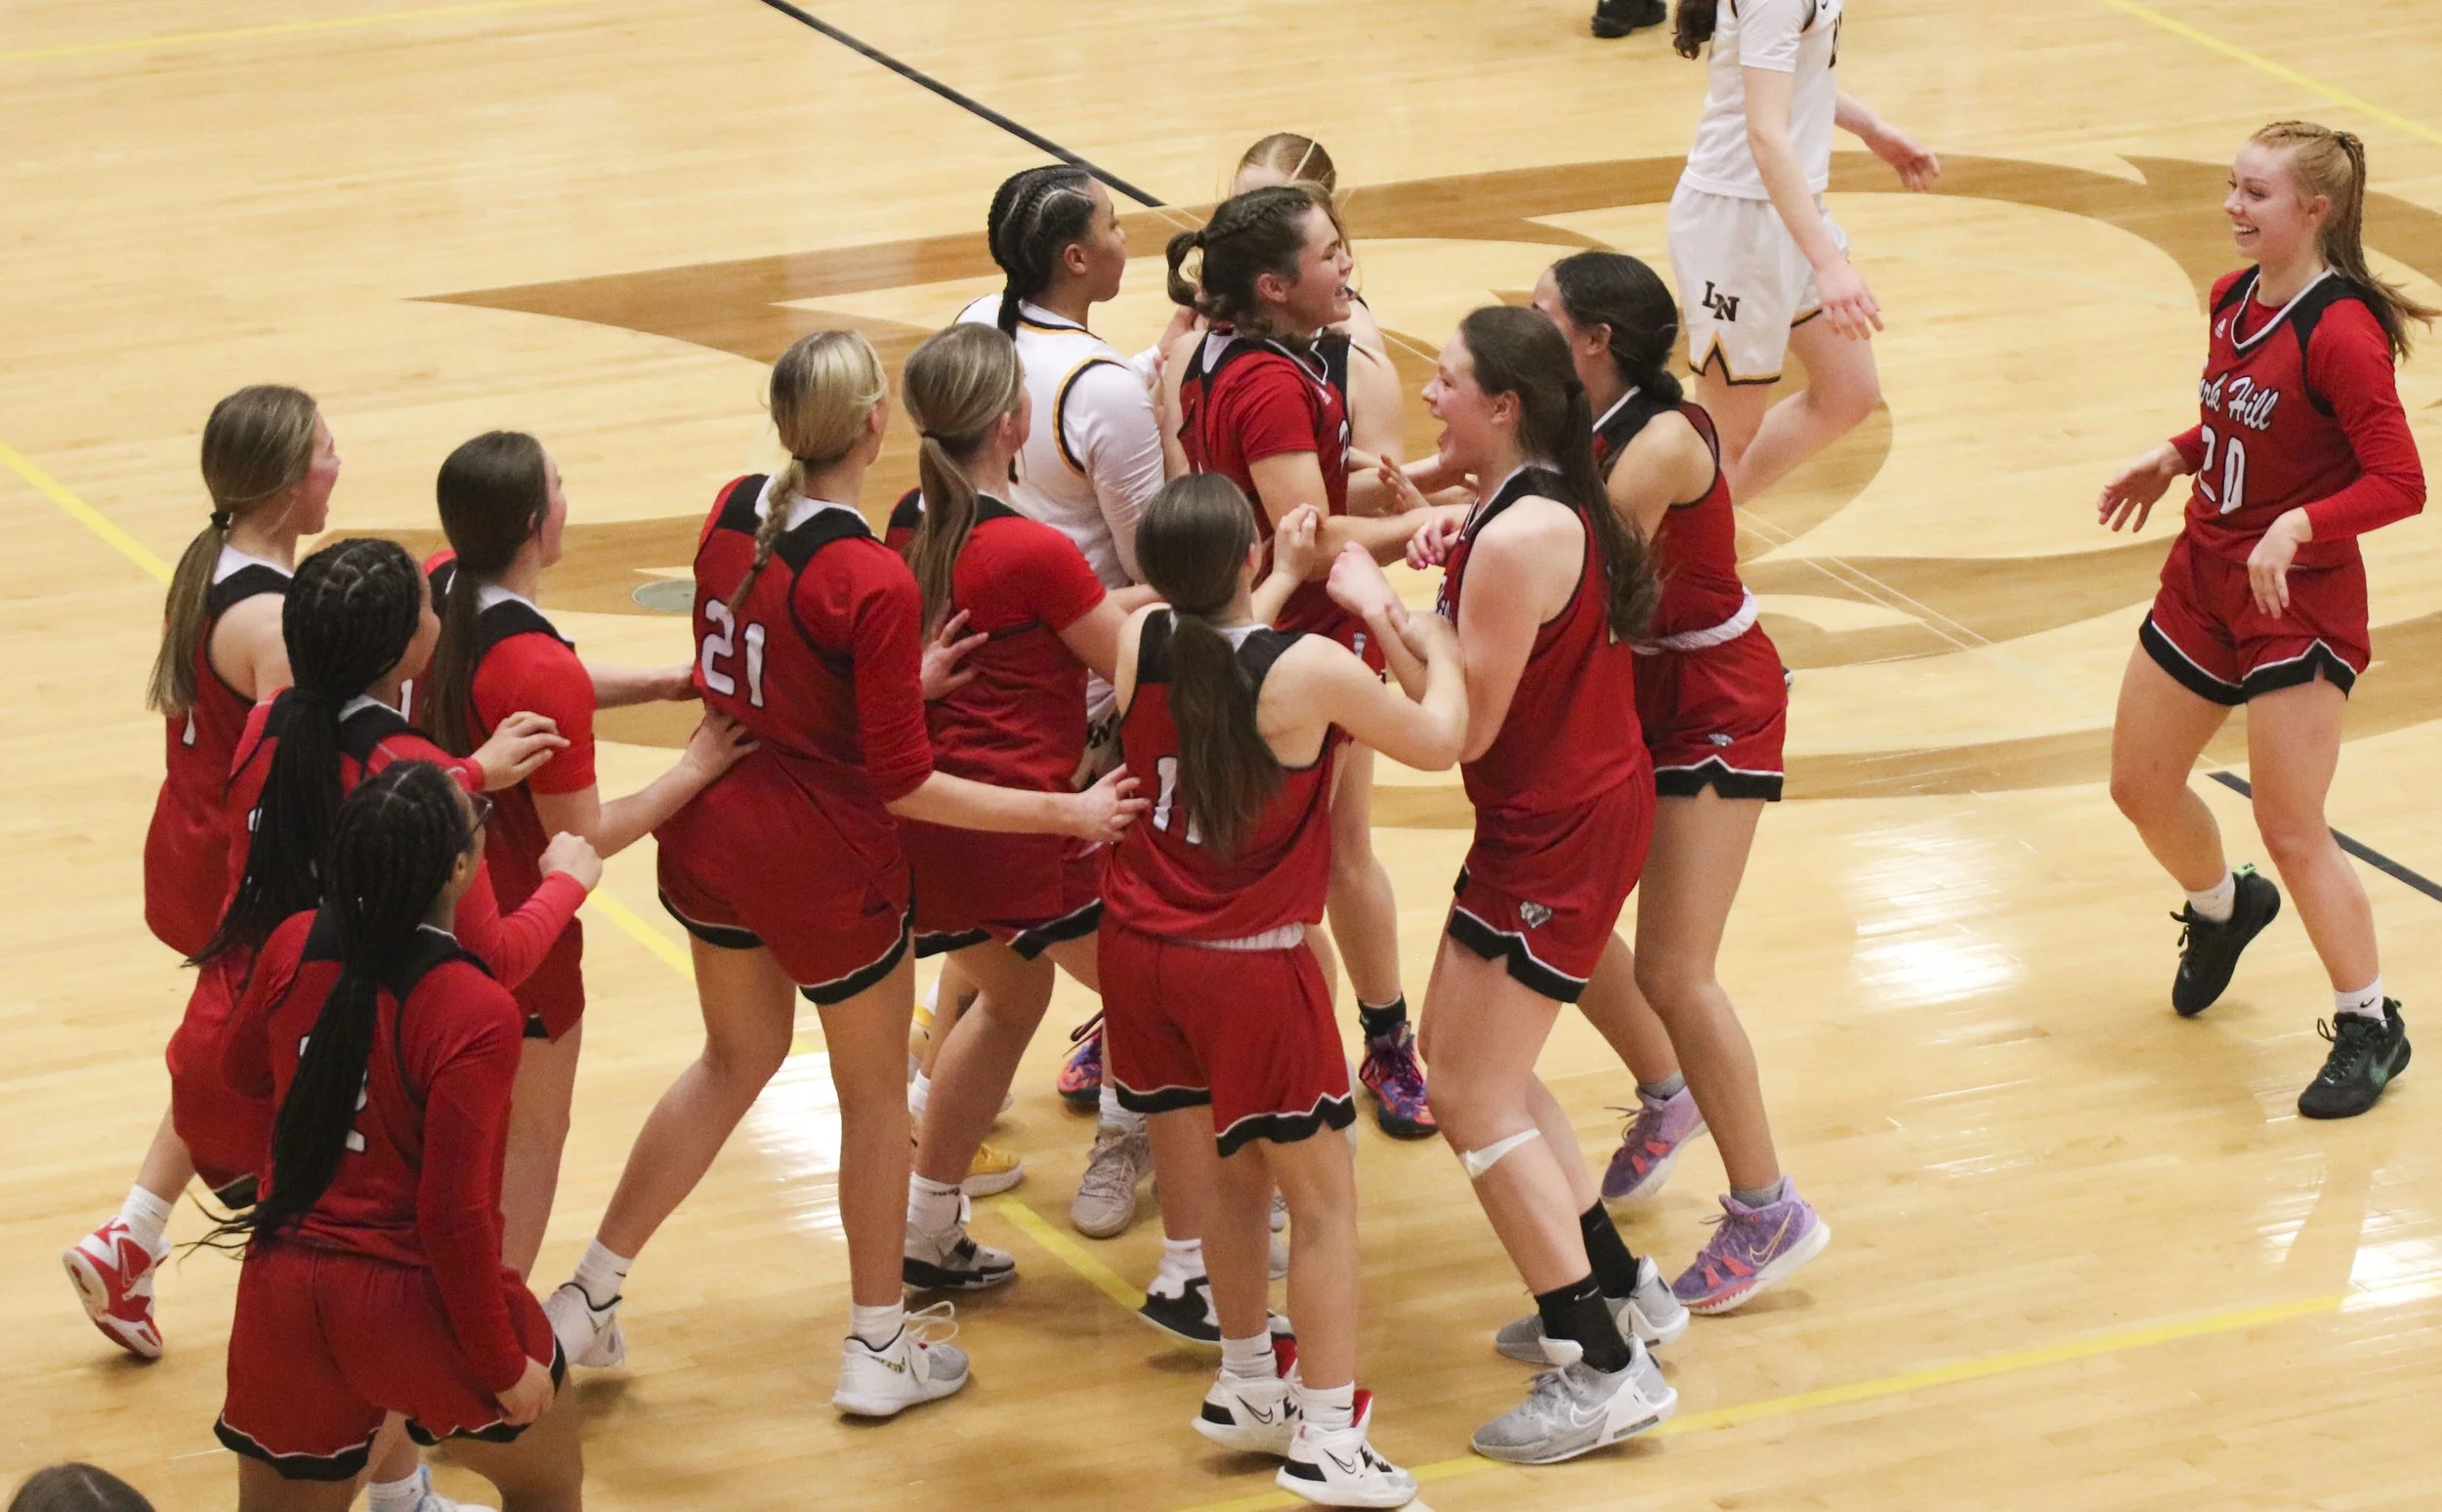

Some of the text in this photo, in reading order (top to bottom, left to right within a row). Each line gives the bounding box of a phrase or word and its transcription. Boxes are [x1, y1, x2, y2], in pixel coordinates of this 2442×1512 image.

[1702, 279, 1741, 322] LN
[2199, 357, 2279, 431] ark Hill
[2198, 424, 2246, 515] 20
[701, 598, 766, 708] 21
